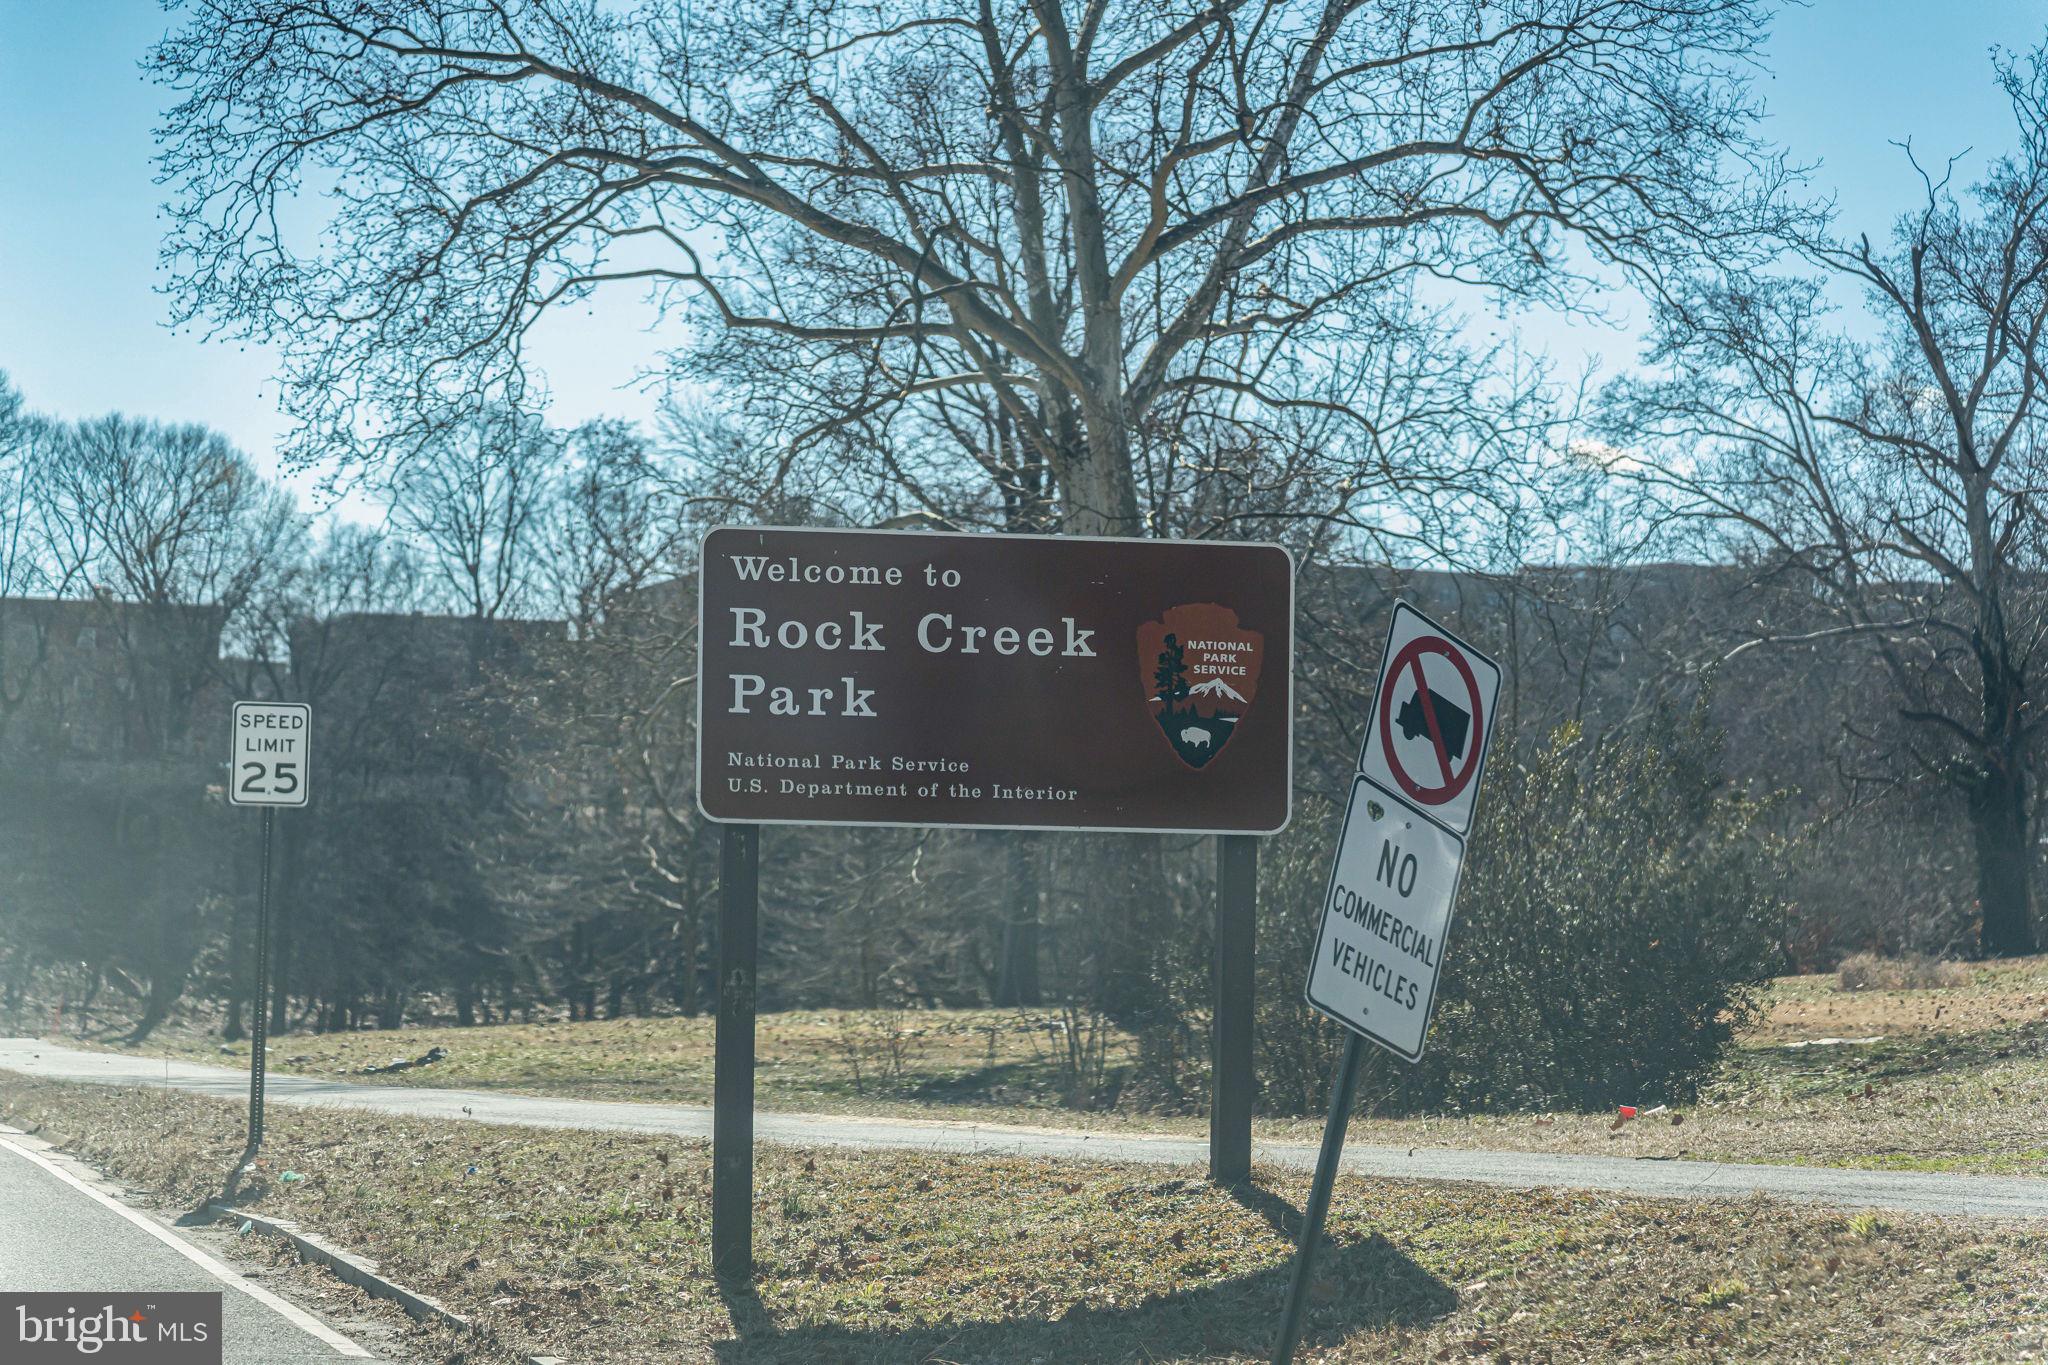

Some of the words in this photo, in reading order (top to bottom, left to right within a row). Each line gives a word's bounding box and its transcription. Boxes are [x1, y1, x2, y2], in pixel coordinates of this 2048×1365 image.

[729, 555, 902, 585] Welcome
[923, 563, 961, 587] to
[728, 607, 886, 651] Rock
[917, 613, 1097, 657] Creek
[1187, 640, 1254, 652] NATIONAL
[1203, 653, 1237, 663] PARK
[1193, 664, 1247, 676] SERVICE
[728, 674, 877, 717] Park
[240, 714, 303, 729] SPEED
[246, 737, 296, 753] LIMIT
[727, 752, 821, 769] National
[831, 754, 882, 771] Park
[891, 756, 970, 773] Service
[241, 761, 298, 794] 25
[727, 778, 768, 793] U.S.
[779, 779, 907, 798] Department
[918, 782, 938, 797] of
[949, 783, 982, 799] the
[992, 784, 1078, 801] Interior
[1376, 838, 1418, 898] NO
[1332, 884, 1434, 968] COMMERCIAL
[1332, 937, 1418, 1011] VEHICLES
